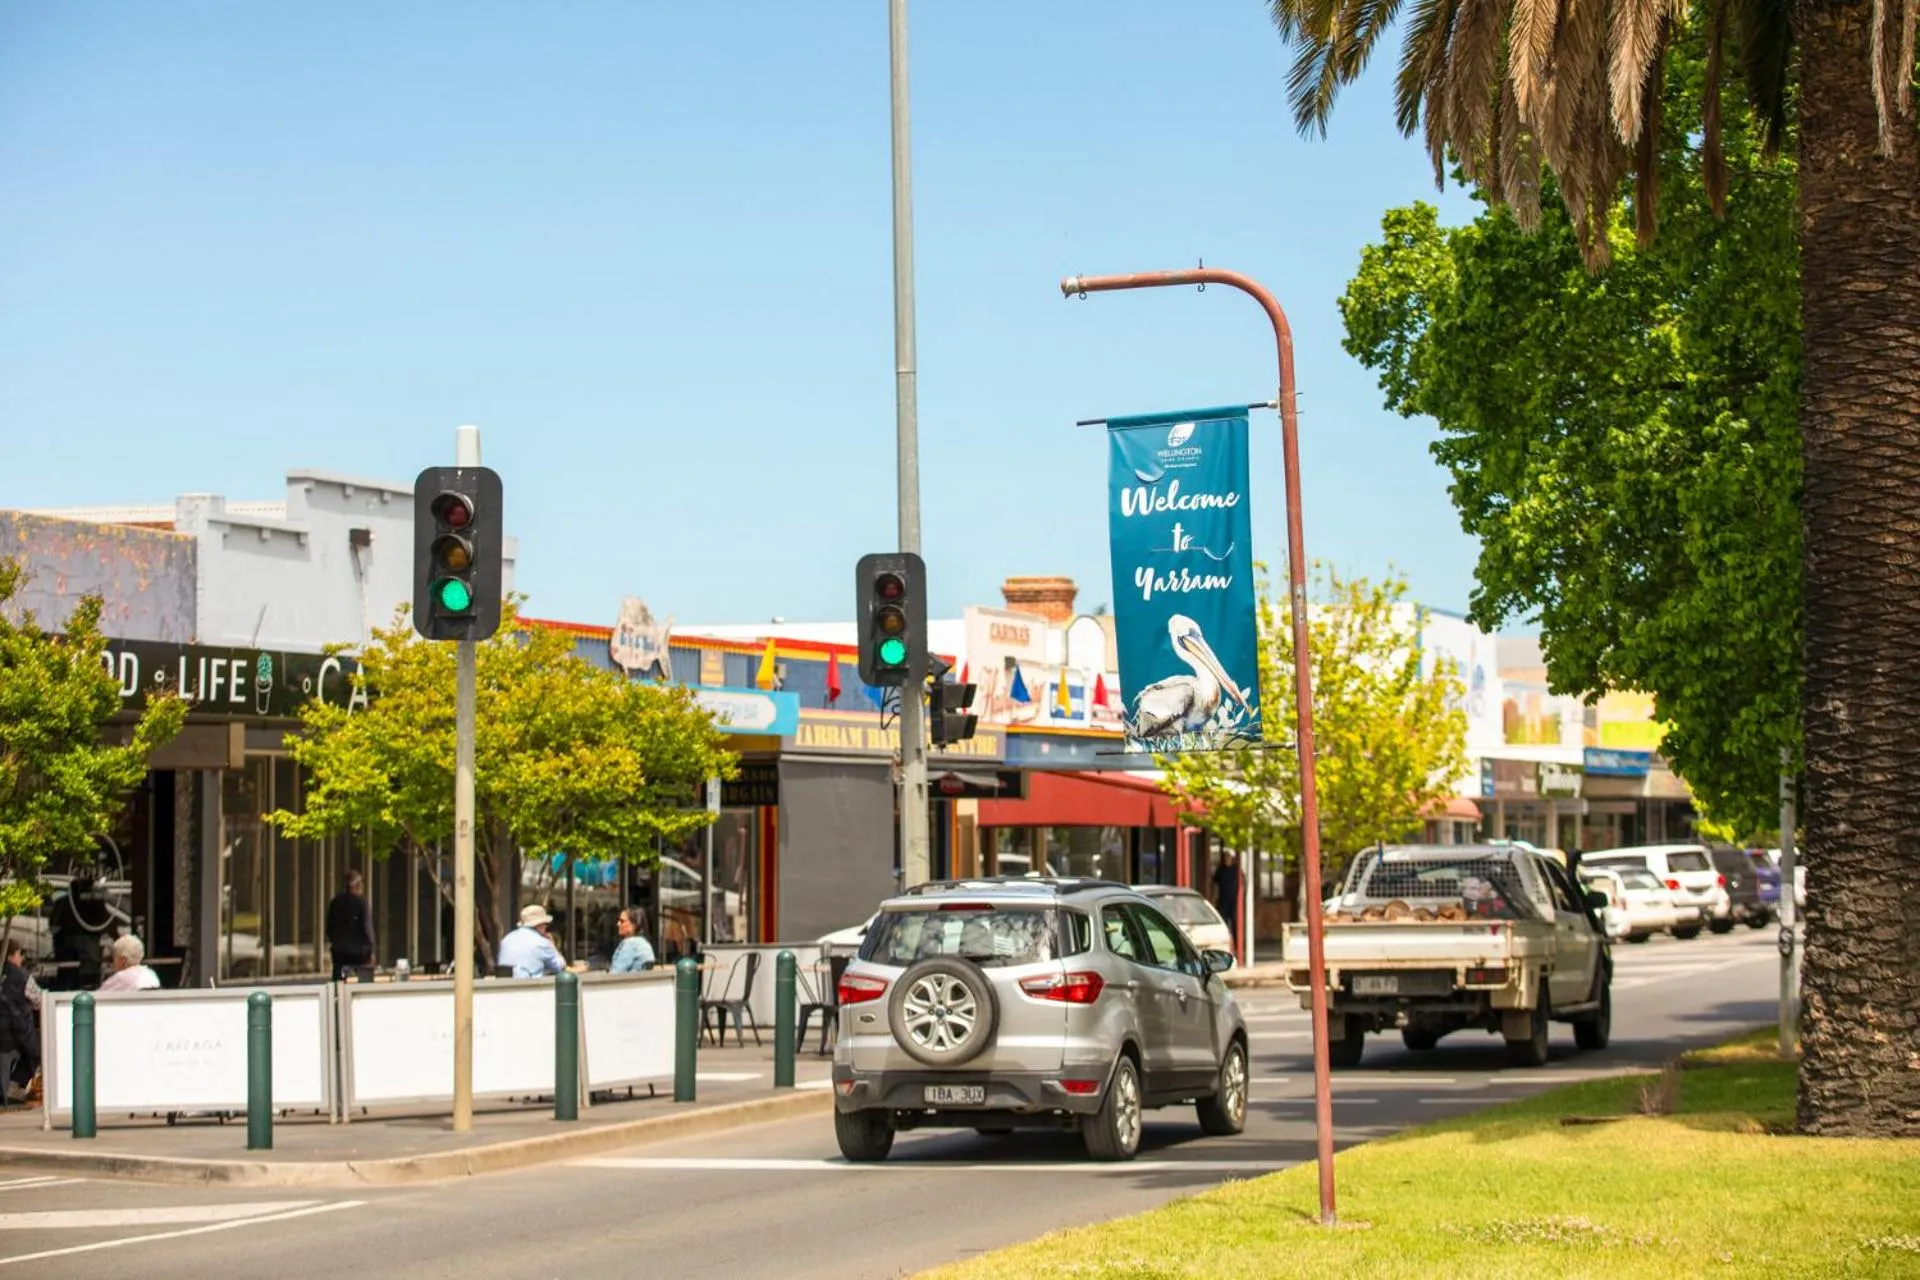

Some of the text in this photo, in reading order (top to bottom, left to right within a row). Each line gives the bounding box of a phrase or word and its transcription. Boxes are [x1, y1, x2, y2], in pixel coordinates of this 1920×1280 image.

[1121, 479, 1240, 517] Welcome
[1171, 522, 1195, 553] to
[1135, 566, 1233, 601] Yarram
[178, 655, 248, 702] LIFE
[317, 656, 368, 718] CA
